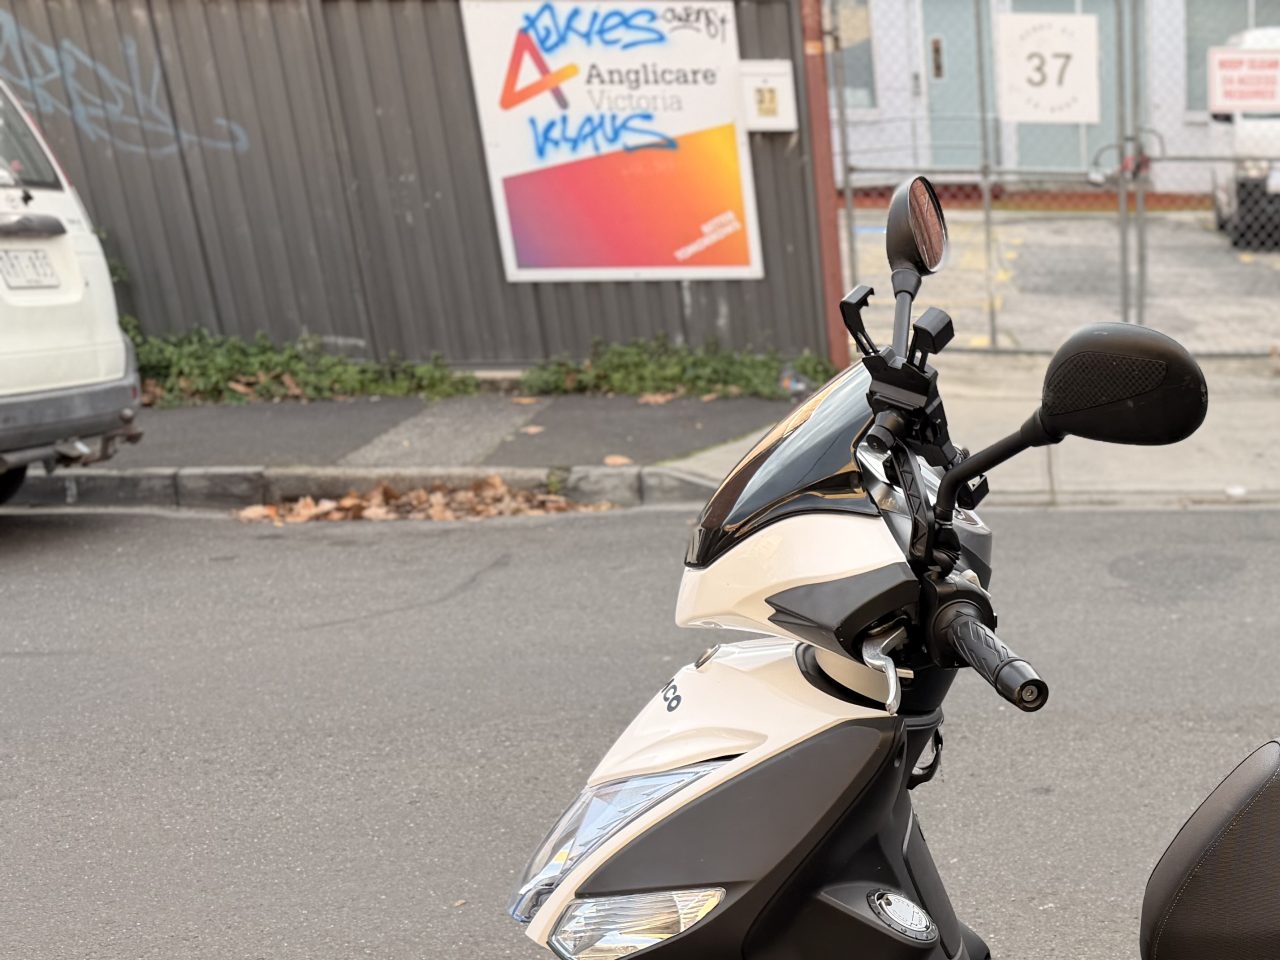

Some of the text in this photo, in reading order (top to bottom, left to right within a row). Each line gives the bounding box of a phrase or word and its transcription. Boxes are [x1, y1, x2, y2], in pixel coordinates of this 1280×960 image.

[585, 63, 717, 90] Anglicare
[1025, 51, 1073, 87] 37
[587, 89, 684, 113] Victoria
